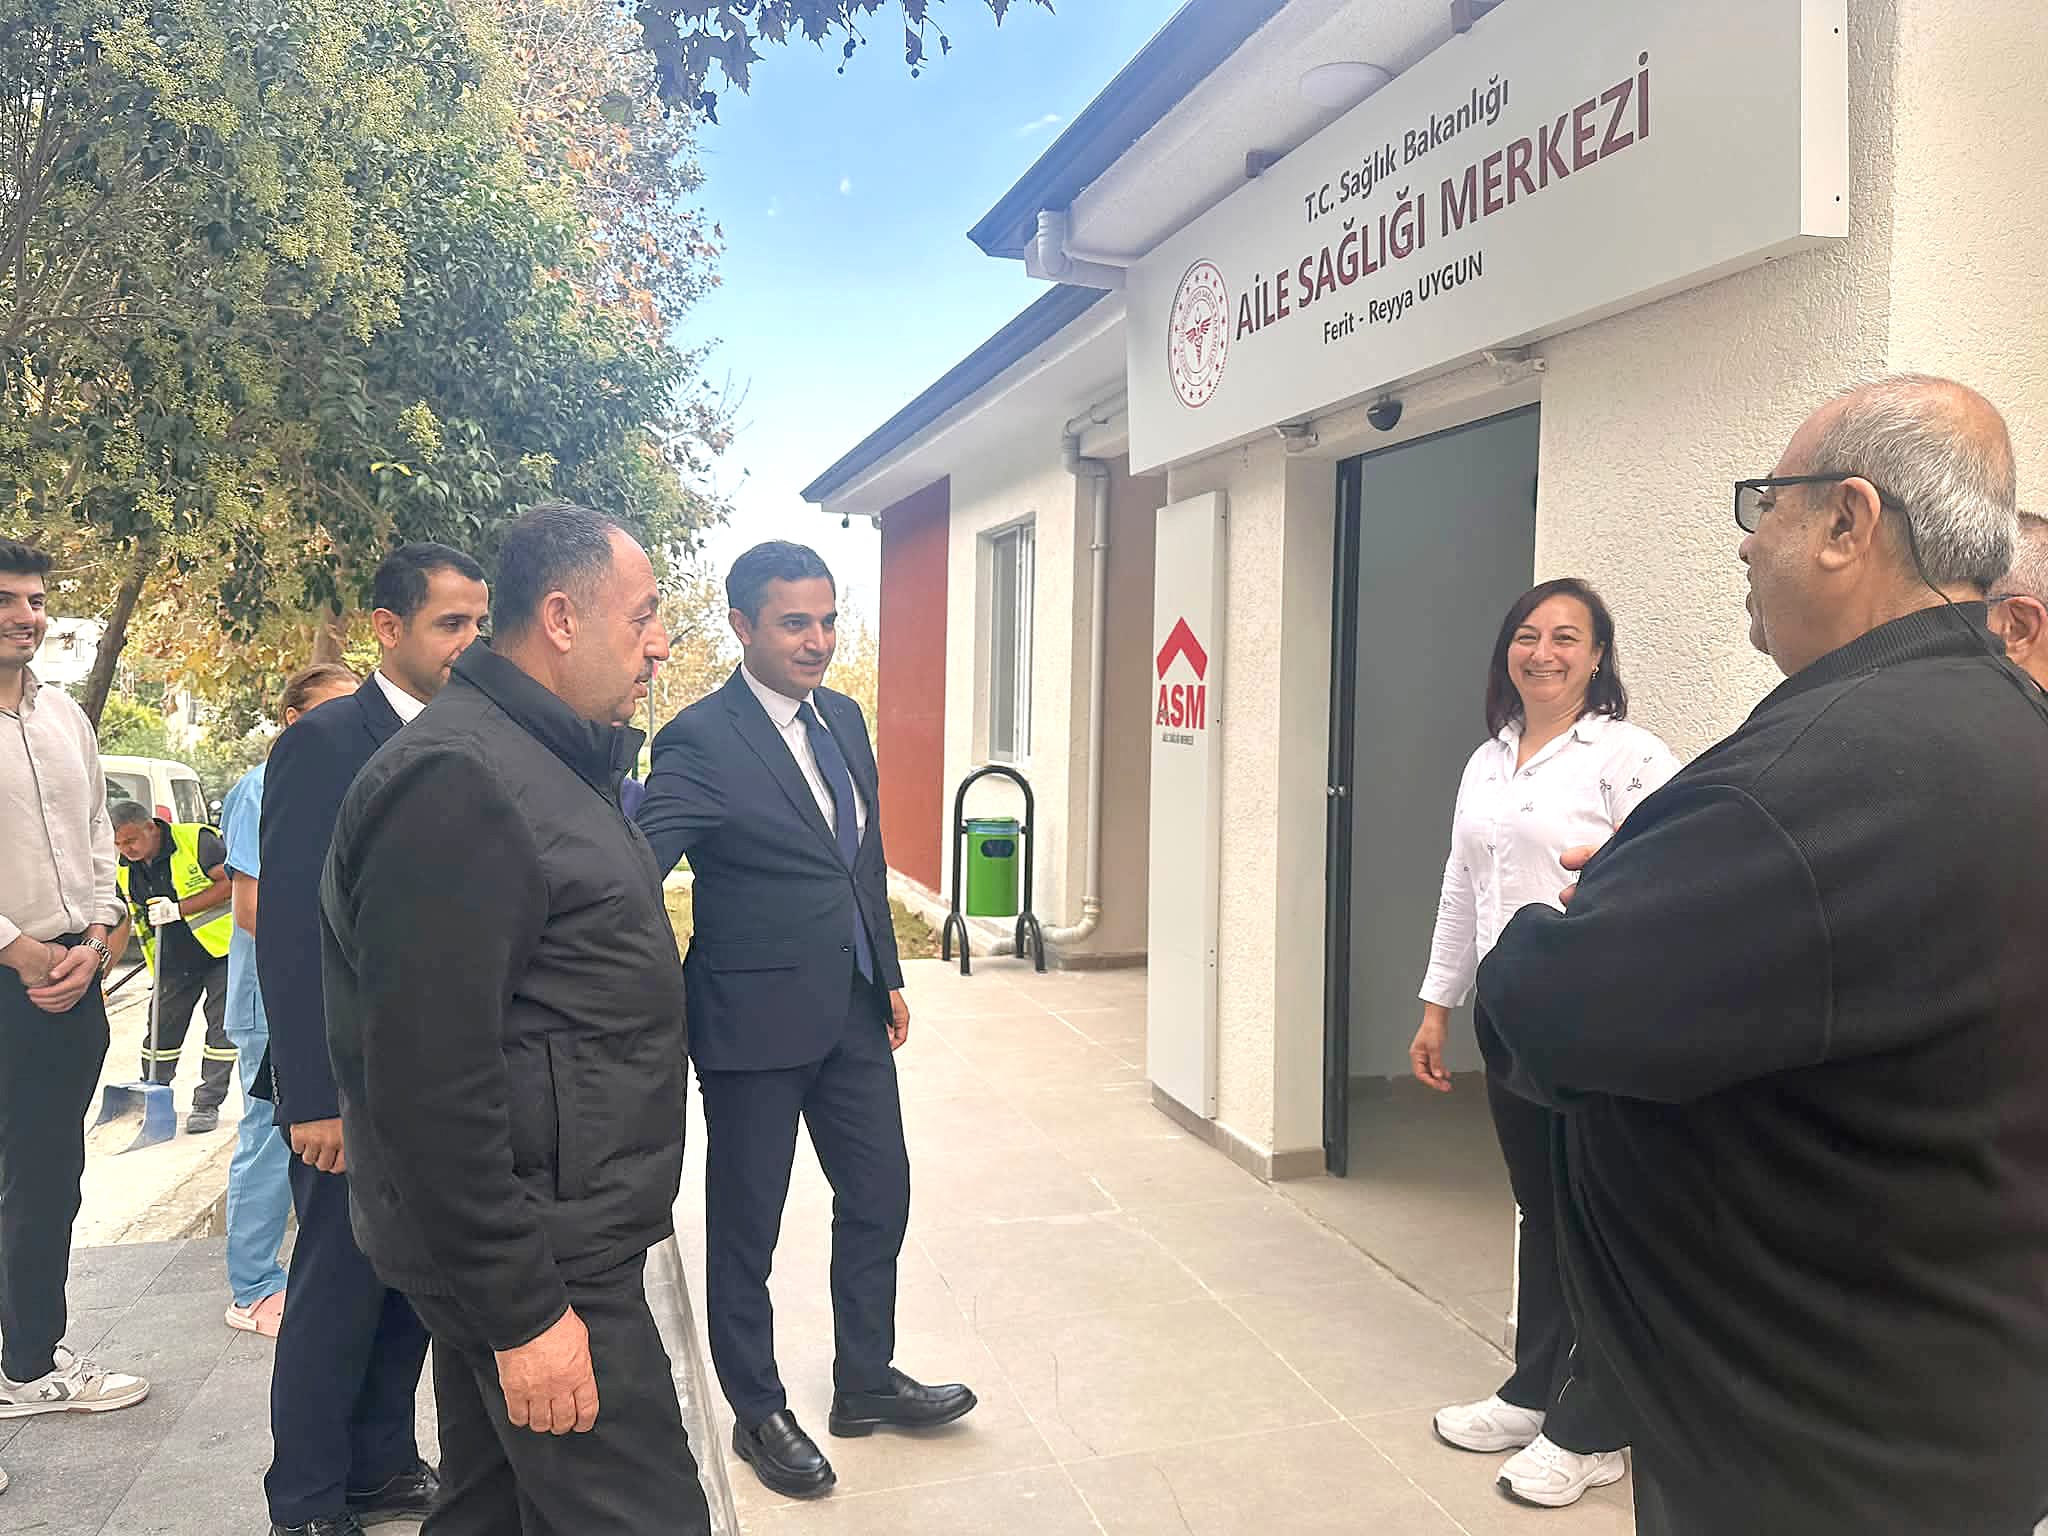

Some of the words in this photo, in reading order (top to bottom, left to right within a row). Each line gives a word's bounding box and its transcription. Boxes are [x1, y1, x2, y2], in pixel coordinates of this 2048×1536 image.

[1236, 269, 1290, 341] AİLE
[1298, 186, 1425, 308] SAĞLIĞI
[1441, 51, 1649, 237] MERKEZİ
[1304, 183, 1334, 222] T.C.
[1340, 143, 1397, 202] Sağlık
[1404, 74, 1508, 166] Bakanlığı
[1323, 312, 1354, 345] Ferit
[1368, 289, 1413, 324] Reyya
[1418, 252, 1483, 302] UYGUN
[1156, 684, 1206, 730] ASM
